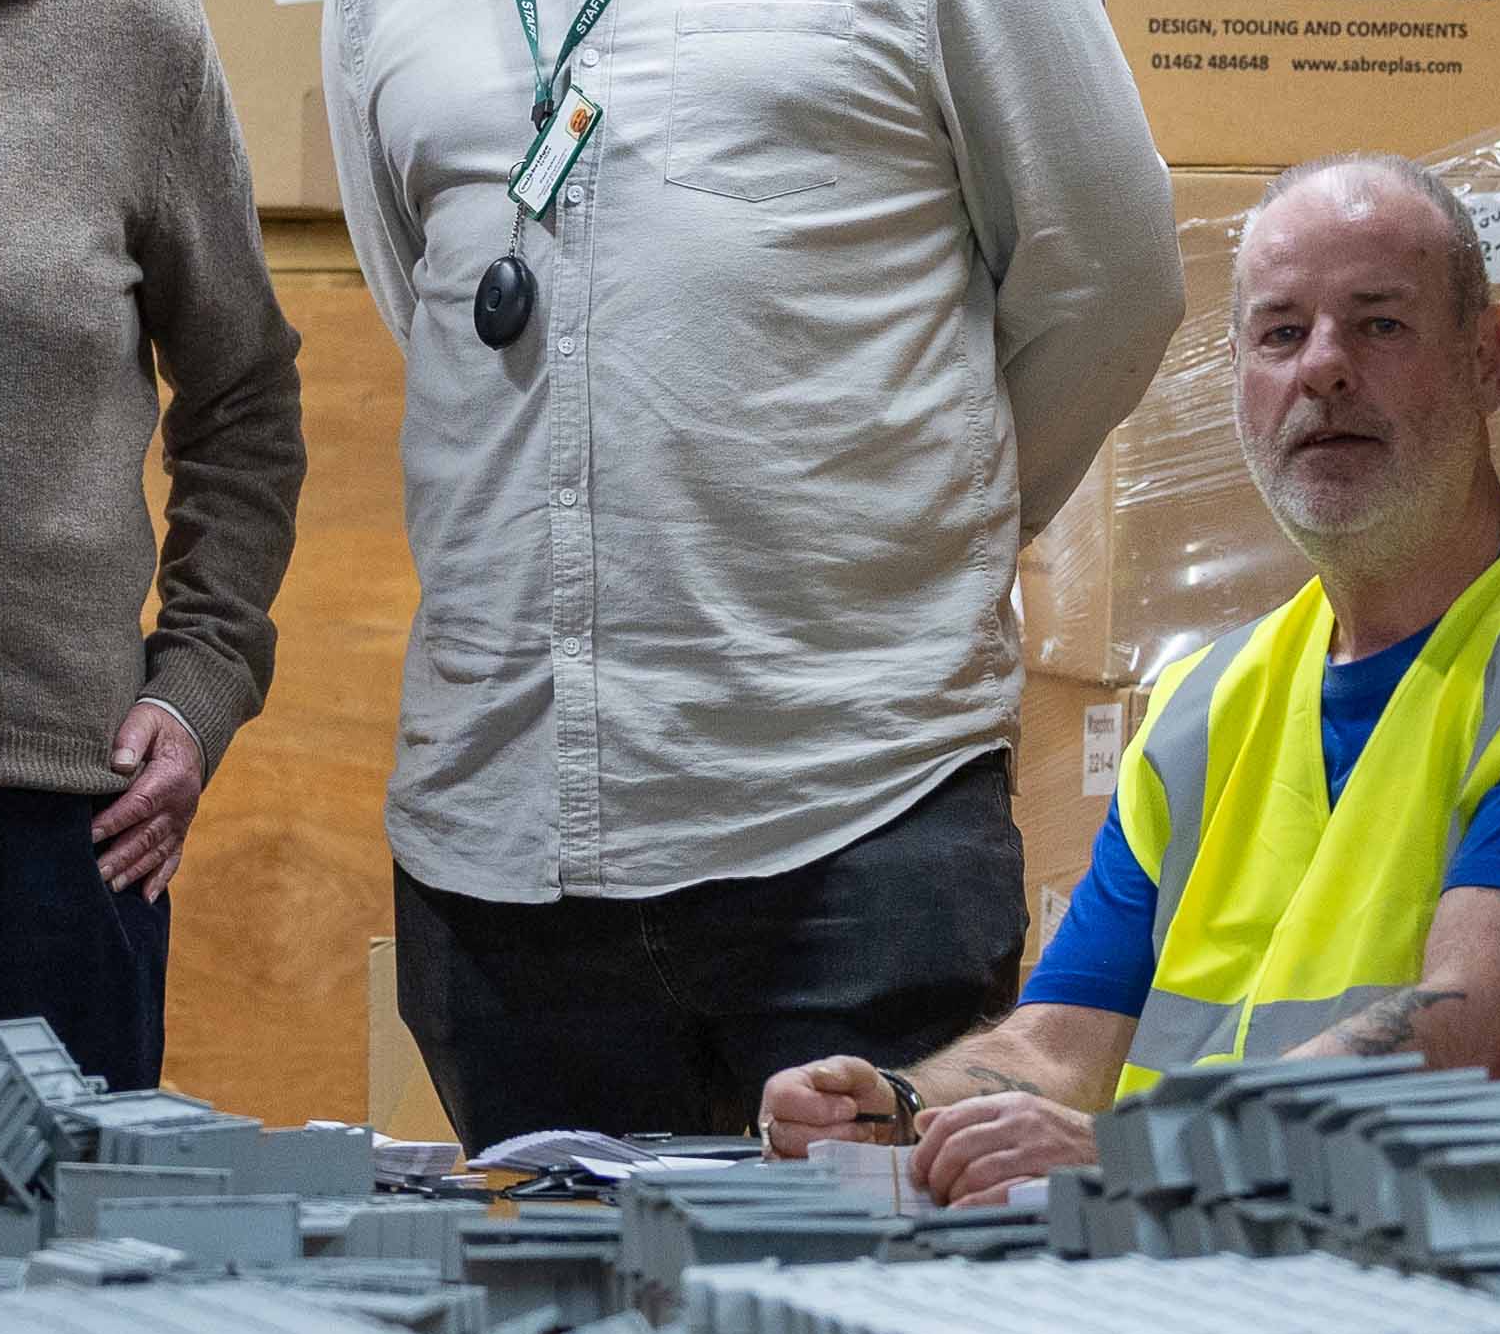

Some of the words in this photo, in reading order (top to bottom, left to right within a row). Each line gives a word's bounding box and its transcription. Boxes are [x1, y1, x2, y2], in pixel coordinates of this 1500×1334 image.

[521, 0, 538, 42] STAFF
[1148, 18, 1217, 37] DESIGN,
[1223, 19, 1299, 37] TOOLING
[1304, 20, 1342, 37] AND
[1346, 21, 1468, 40] COMPONENTS
[1151, 53, 1203, 71] 01462
[1207, 54, 1270, 71] 484648
[1292, 56, 1463, 77] www.sabreplas.com
